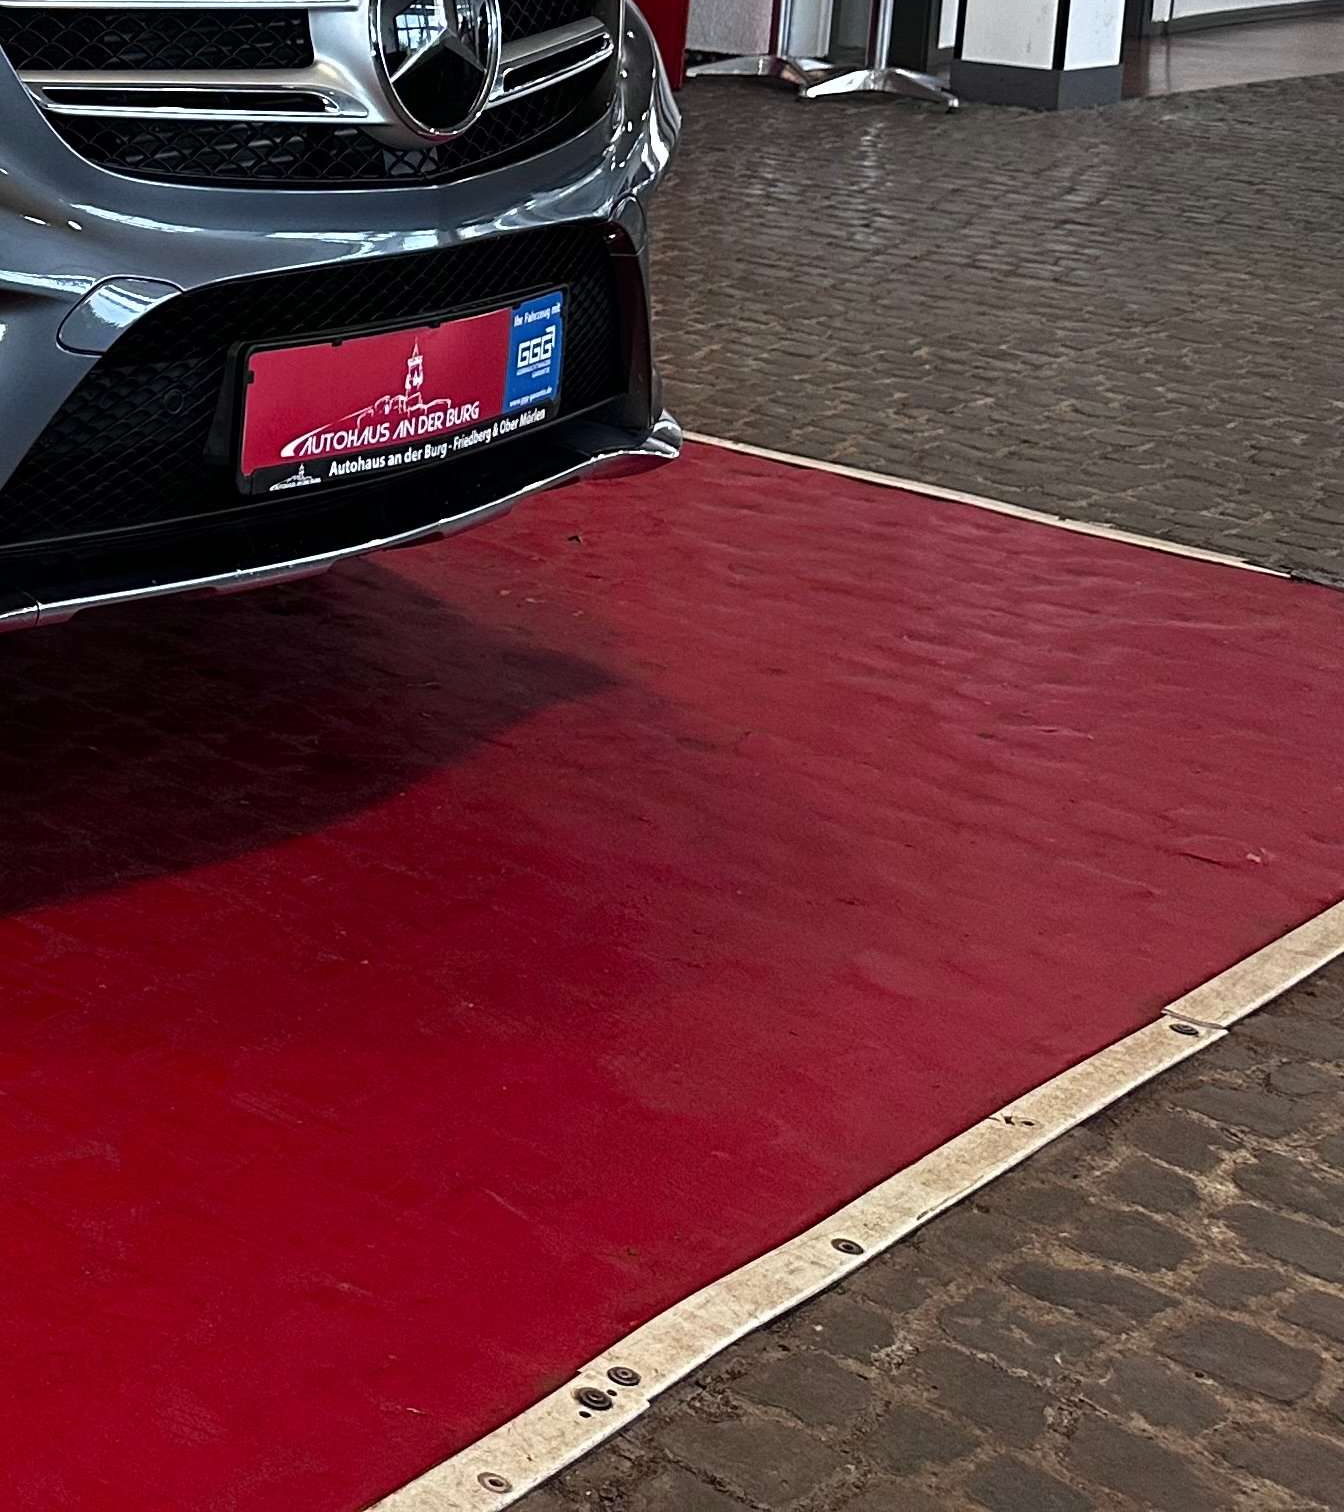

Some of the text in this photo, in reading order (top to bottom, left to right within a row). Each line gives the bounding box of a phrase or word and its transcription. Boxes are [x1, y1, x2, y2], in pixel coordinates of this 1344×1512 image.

[517, 331, 554, 369] GGG
[298, 401, 480, 457] AUTOHAUS AN DER BURG
[328, 455, 386, 477] Autohaus
[387, 452, 402, 466] an
[403, 446, 423, 463] der
[424, 442, 448, 459] Burg
[453, 426, 492, 452] Friedberg
[499, 419, 519, 435] Ober
[519, 408, 546, 428] Mörlen
